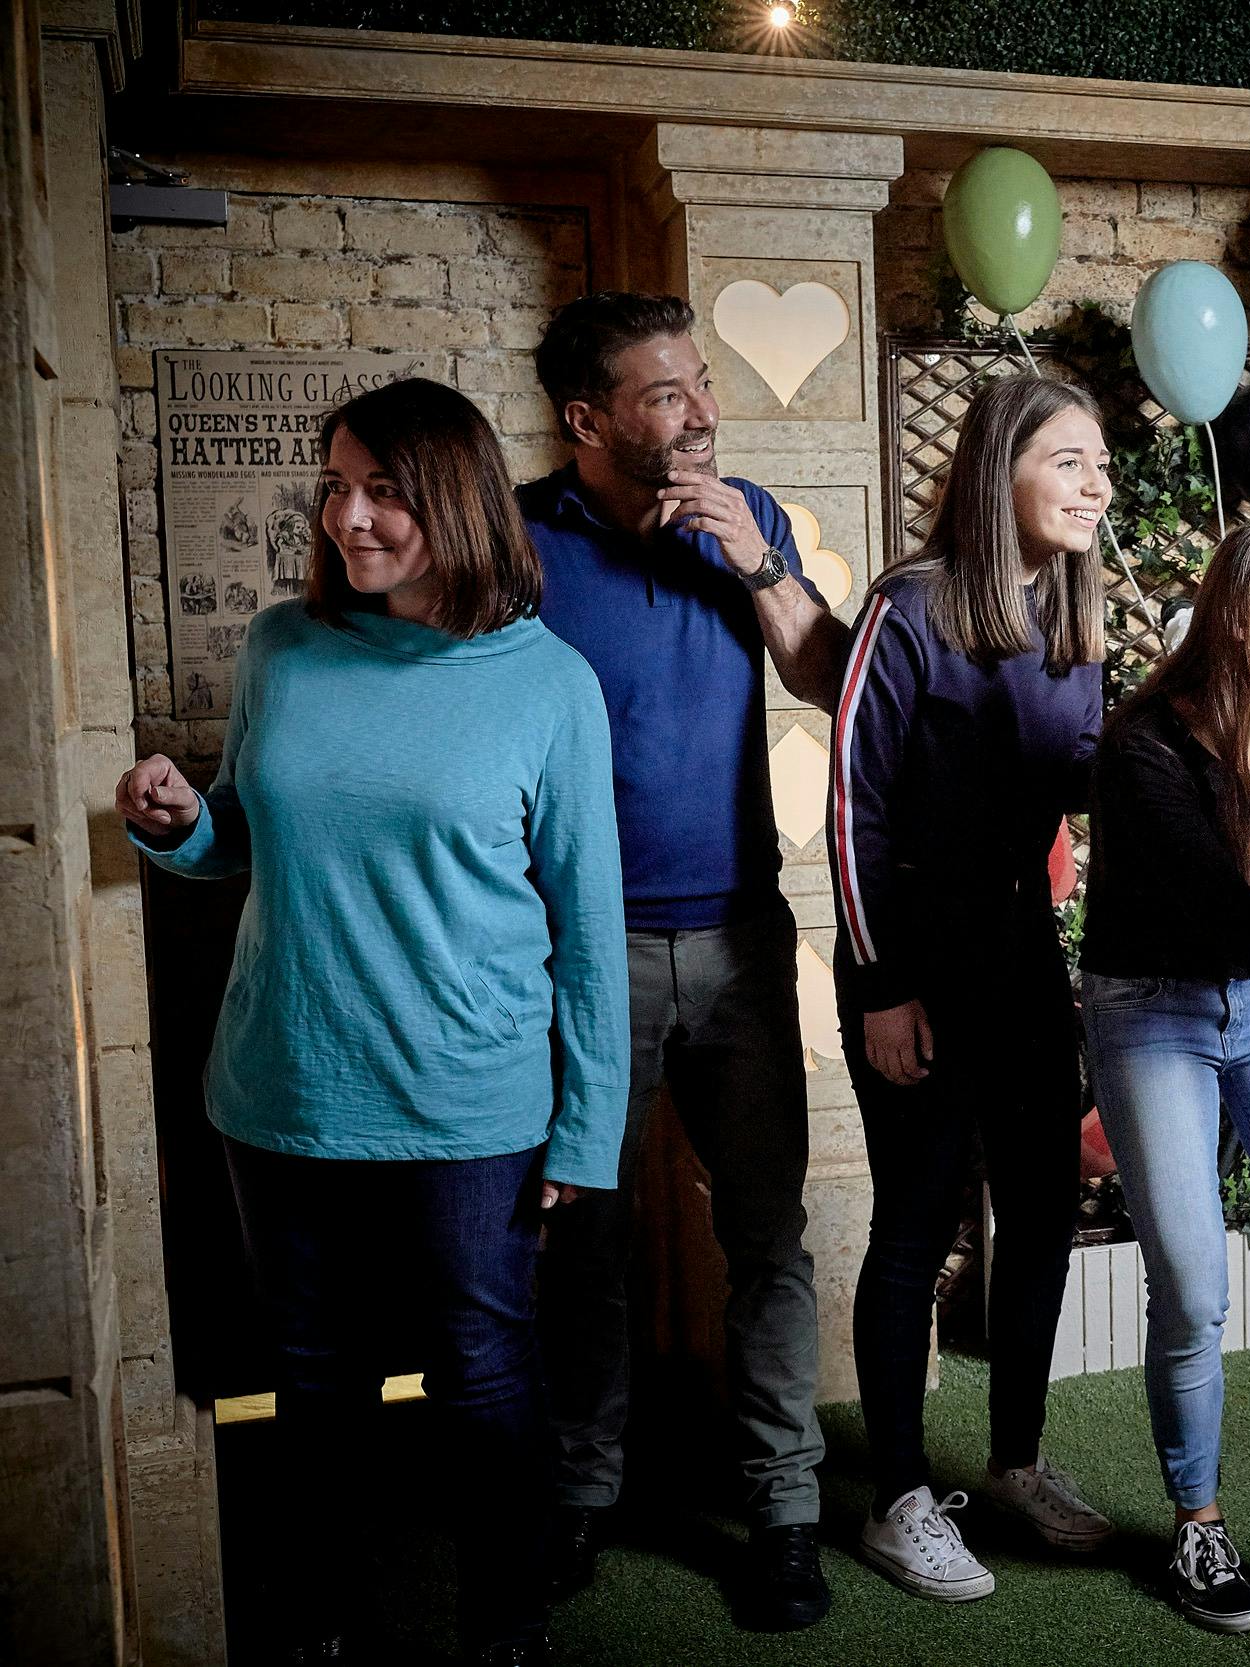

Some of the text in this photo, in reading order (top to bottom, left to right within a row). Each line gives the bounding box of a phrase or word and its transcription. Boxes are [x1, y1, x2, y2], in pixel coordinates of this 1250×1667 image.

[182, 359, 202, 371] THE
[163, 355, 293, 402] LOOKING
[168, 413, 258, 435] QUEEN'S
[169, 437, 284, 466] HATTER
[170, 470, 257, 479] MISSING WONDERLAND EGGS
